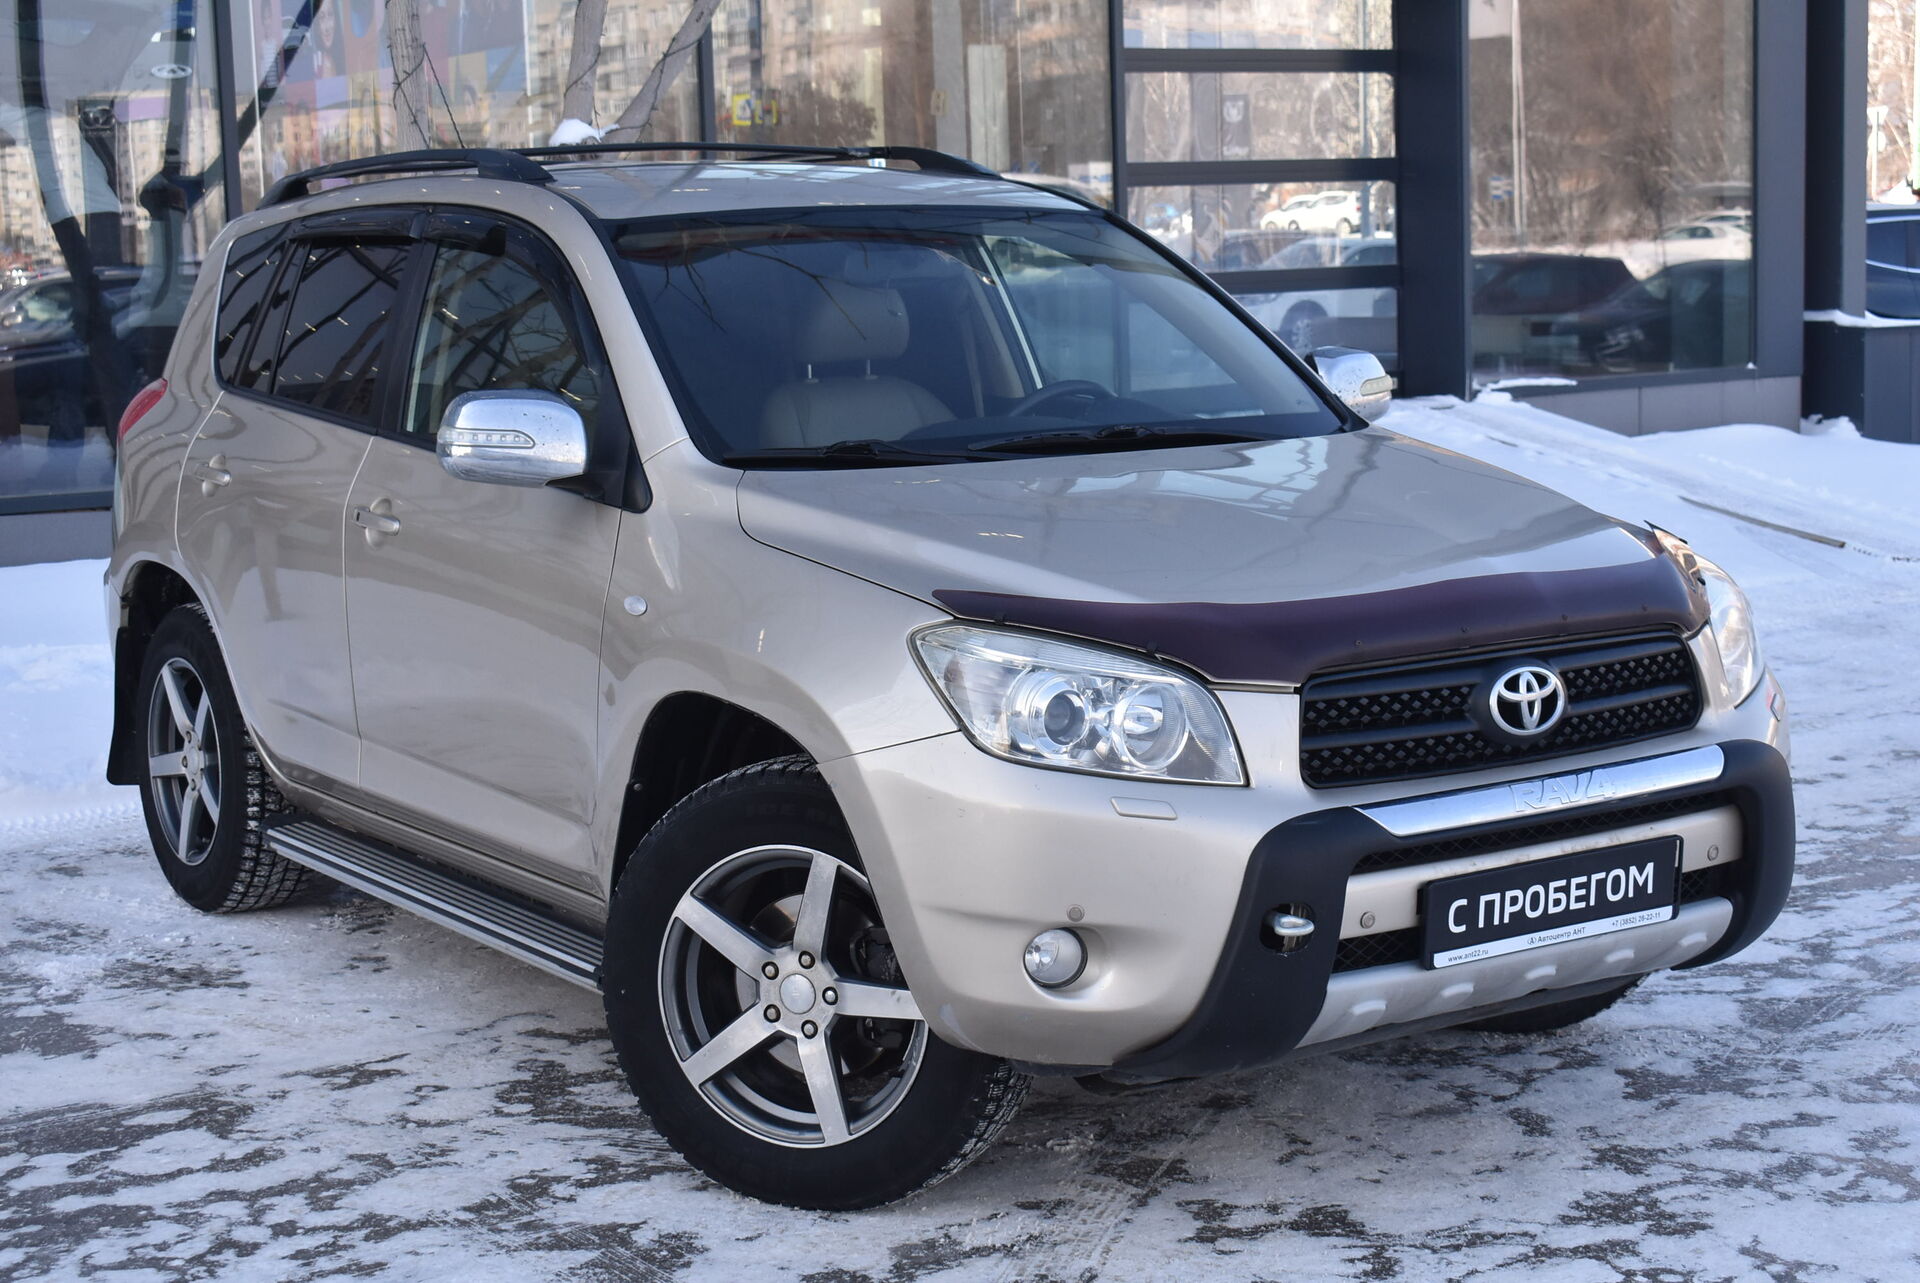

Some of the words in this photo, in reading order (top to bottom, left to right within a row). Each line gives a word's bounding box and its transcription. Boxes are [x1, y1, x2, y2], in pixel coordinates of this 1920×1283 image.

[1509, 771, 1616, 813] RAV4
[1448, 899, 1468, 933] С
[1478, 862, 1654, 928] ПРОБЕГОМ
[1538, 926, 1572, 943] Автоцентр
[1572, 921, 1587, 935] АНТ
[1447, 948, 1489, 962] www.ant22.ru
